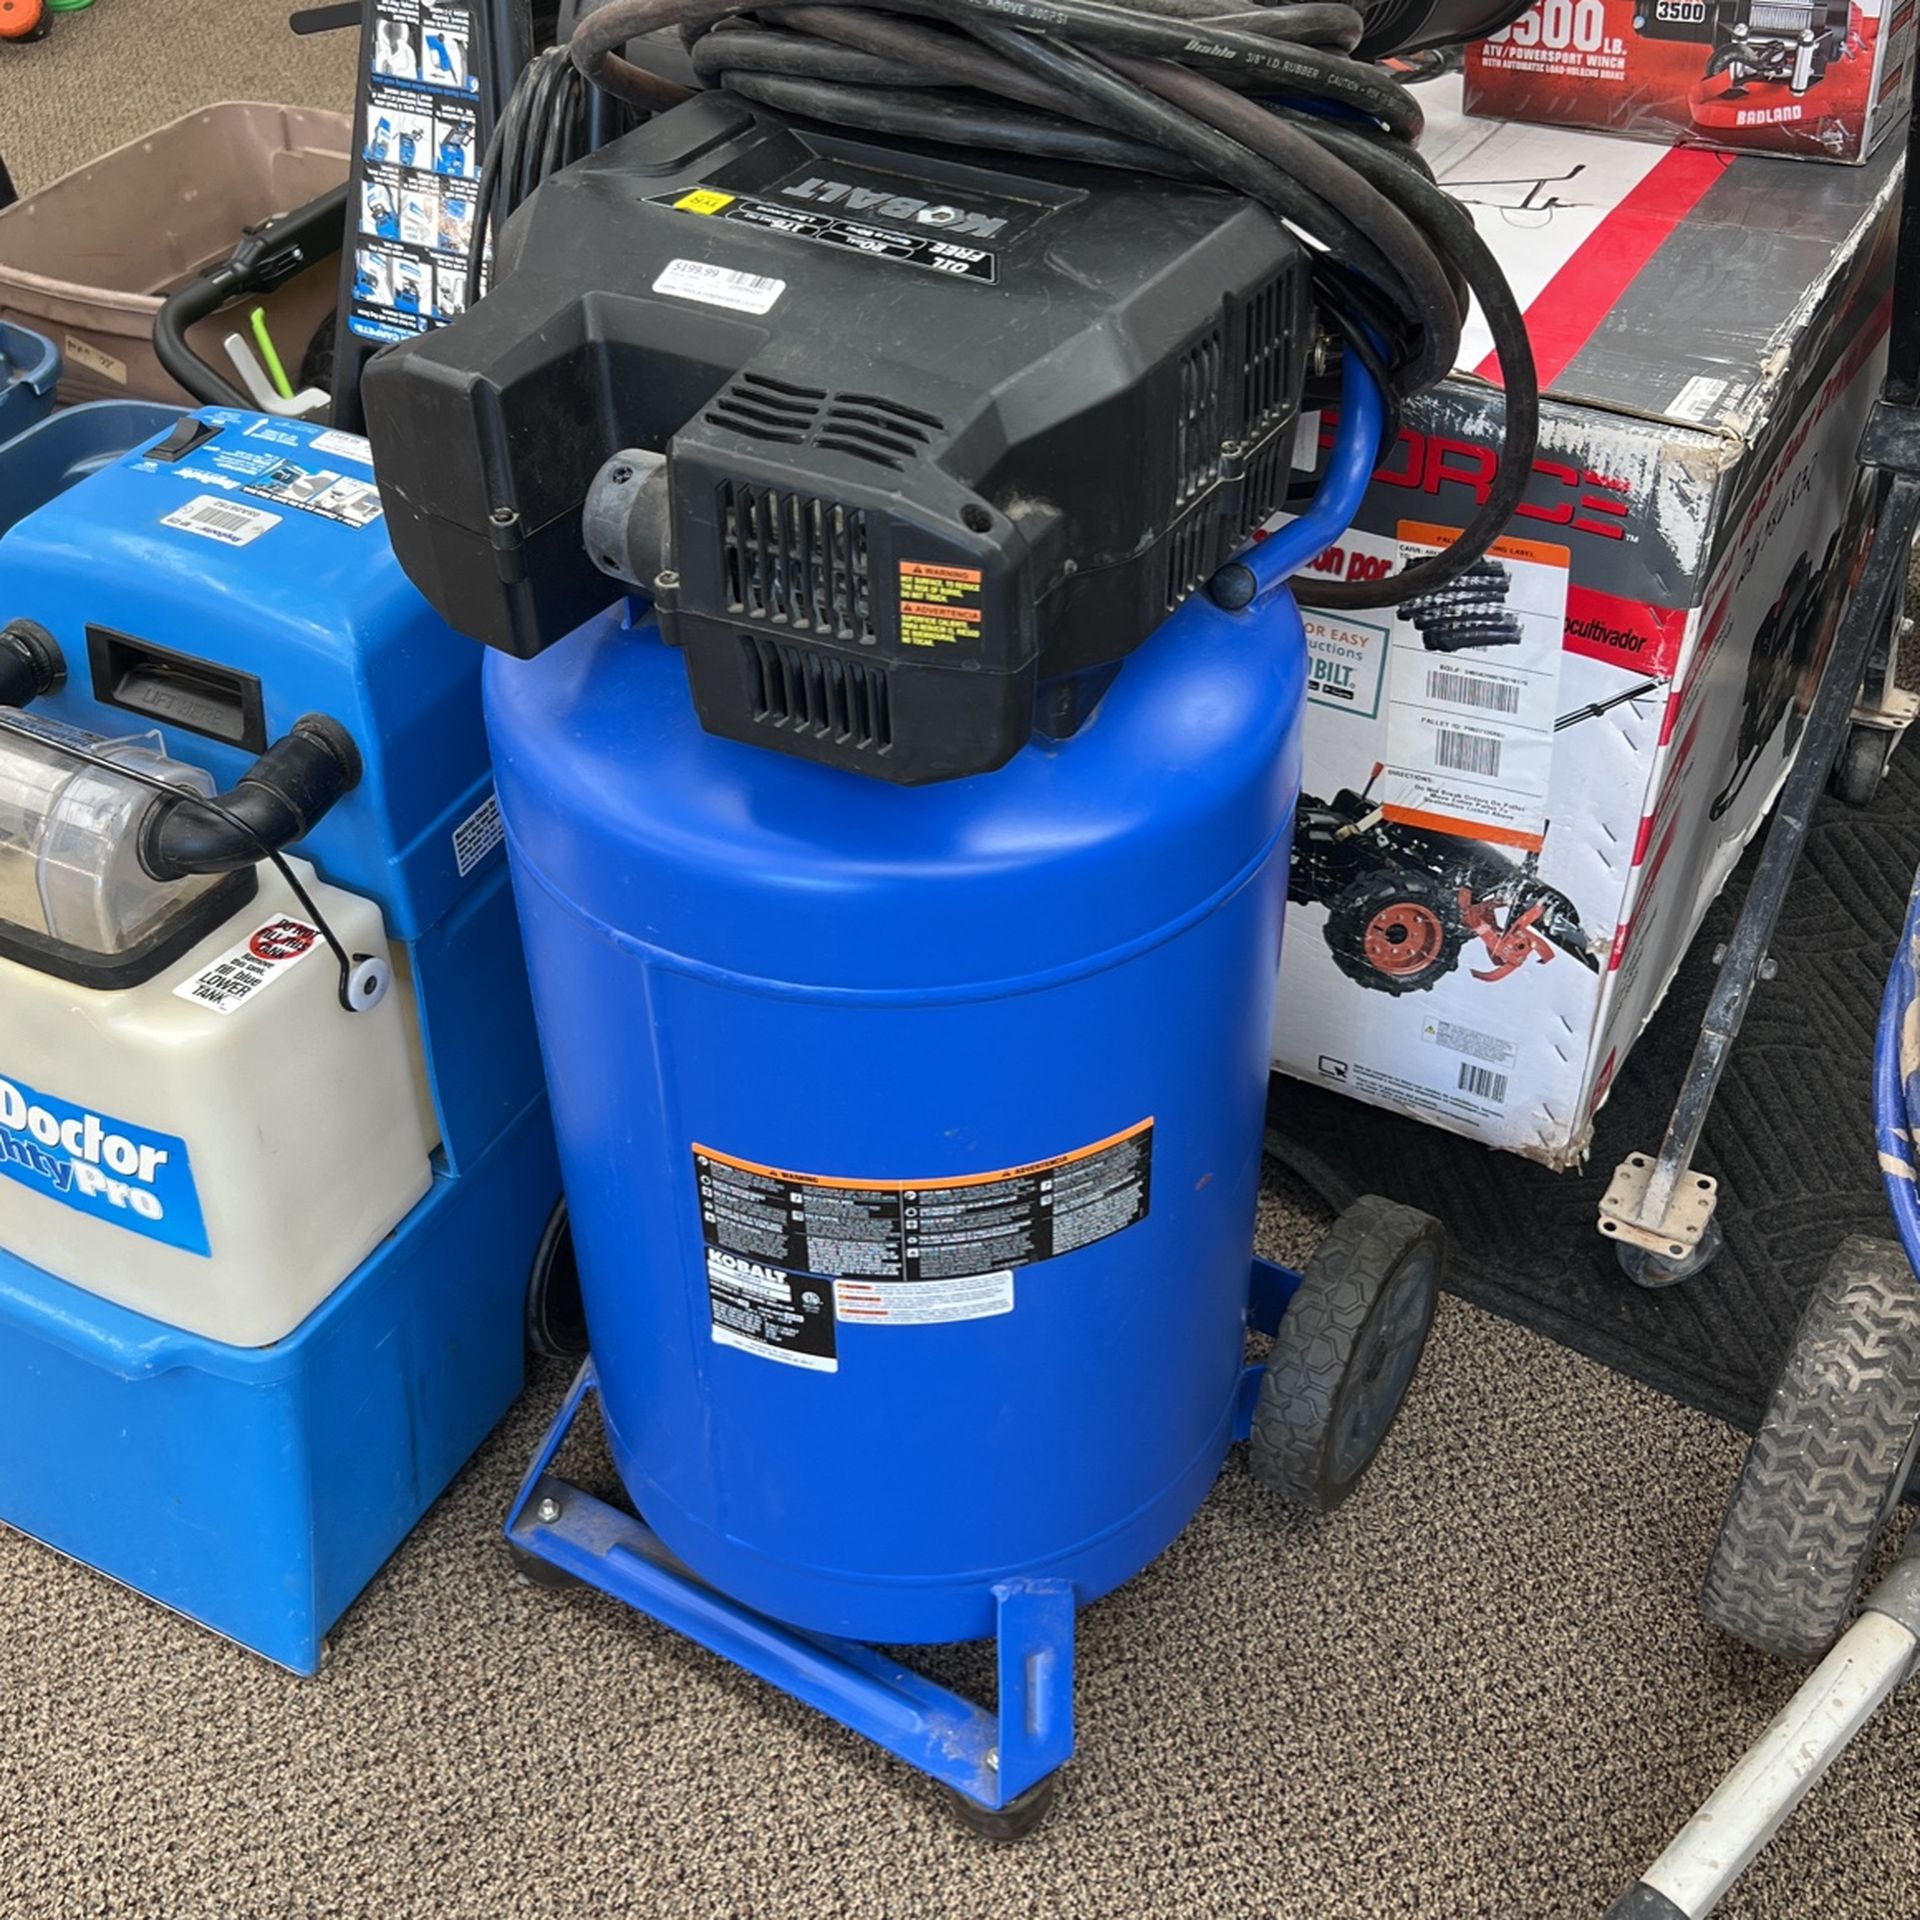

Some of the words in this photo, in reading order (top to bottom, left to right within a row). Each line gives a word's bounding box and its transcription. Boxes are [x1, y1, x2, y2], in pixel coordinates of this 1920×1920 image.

[1658, 2, 1704, 21] 3500
[1184, 39, 1237, 60] Diablo
[1482, 44, 1583, 66] ATV/POWERSPORT
[1586, 55, 1625, 69] WINCH
[1603, 37, 1627, 55] LB.
[1502, 60, 1545, 73] AUTOMATIC
[1736, 105, 1802, 125] BADLAND
[781, 177, 1008, 239] KOBALT
[929, 241, 987, 262] FREE
[930, 255, 970, 274] OIL
[924, 566, 969, 580] WARNING
[1346, 551, 1393, 582] por
[915, 605, 979, 620] ADVERTENCIA
[1303, 621, 1326, 638] OR
[1330, 628, 1370, 649] EASY
[1308, 638, 1364, 661] uctions
[142, 688, 174, 712] LIFT
[177, 700, 226, 726] HERE
[1420, 717, 1449, 728] PALLET
[259, 928, 282, 942] FILL
[284, 935, 311, 951] THIS
[276, 918, 292, 932] DO
[291, 922, 322, 940] NOT
[257, 942, 285, 959] TANK
[198, 971, 252, 998] LOWER
[214, 963, 231, 977] fill
[233, 969, 262, 987] blue
[0, 1078, 169, 1183] Doctor
[0, 1126, 72, 1193] hty
[70, 1157, 164, 1221] Pro
[781, 1171, 819, 1184] WARNING
[707, 1248, 788, 1285] KOBALT
